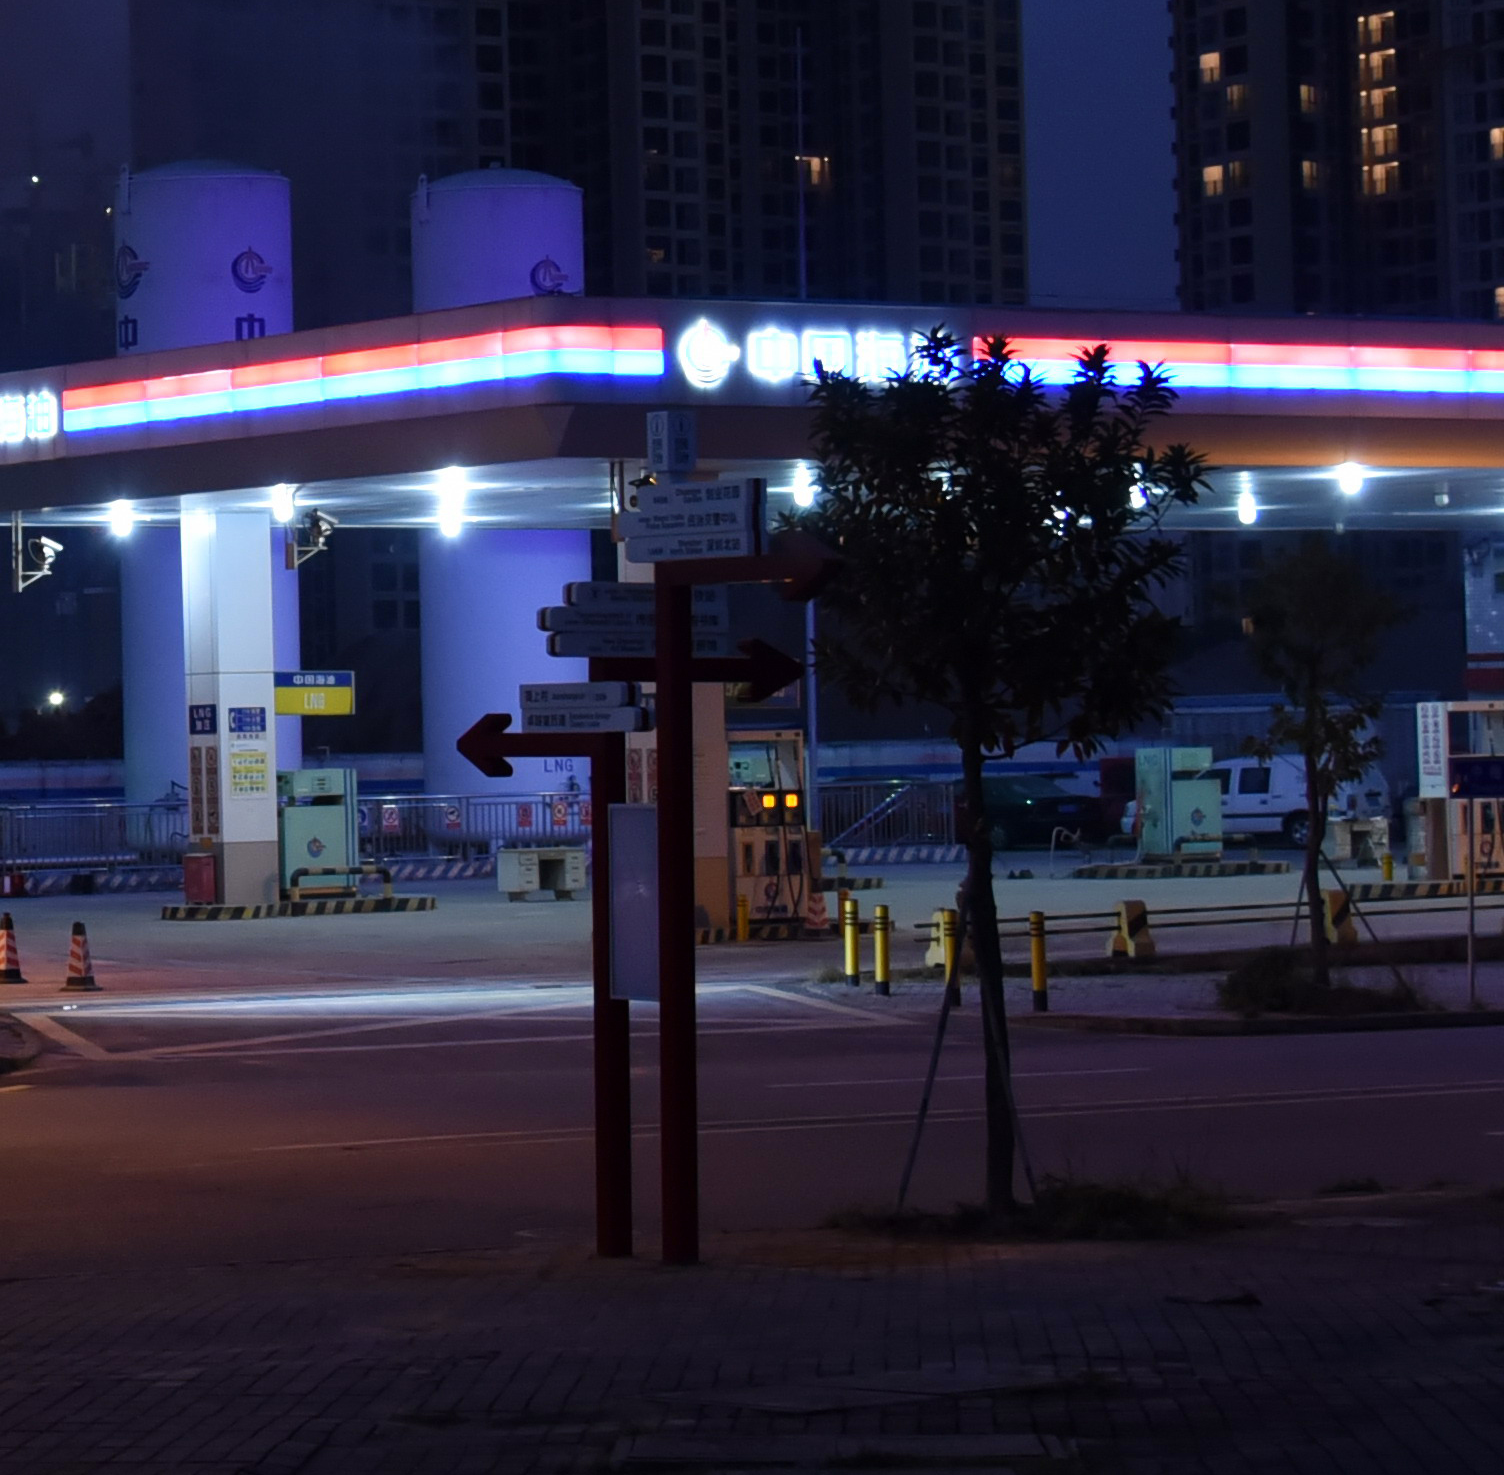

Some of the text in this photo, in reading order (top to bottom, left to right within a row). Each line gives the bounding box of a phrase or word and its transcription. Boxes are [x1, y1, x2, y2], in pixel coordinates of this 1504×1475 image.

[293, 674, 336, 685] 中国海油
[303, 692, 326, 710] LNG
[193, 707, 212, 719] LNG
[543, 759, 574, 774] LNG
